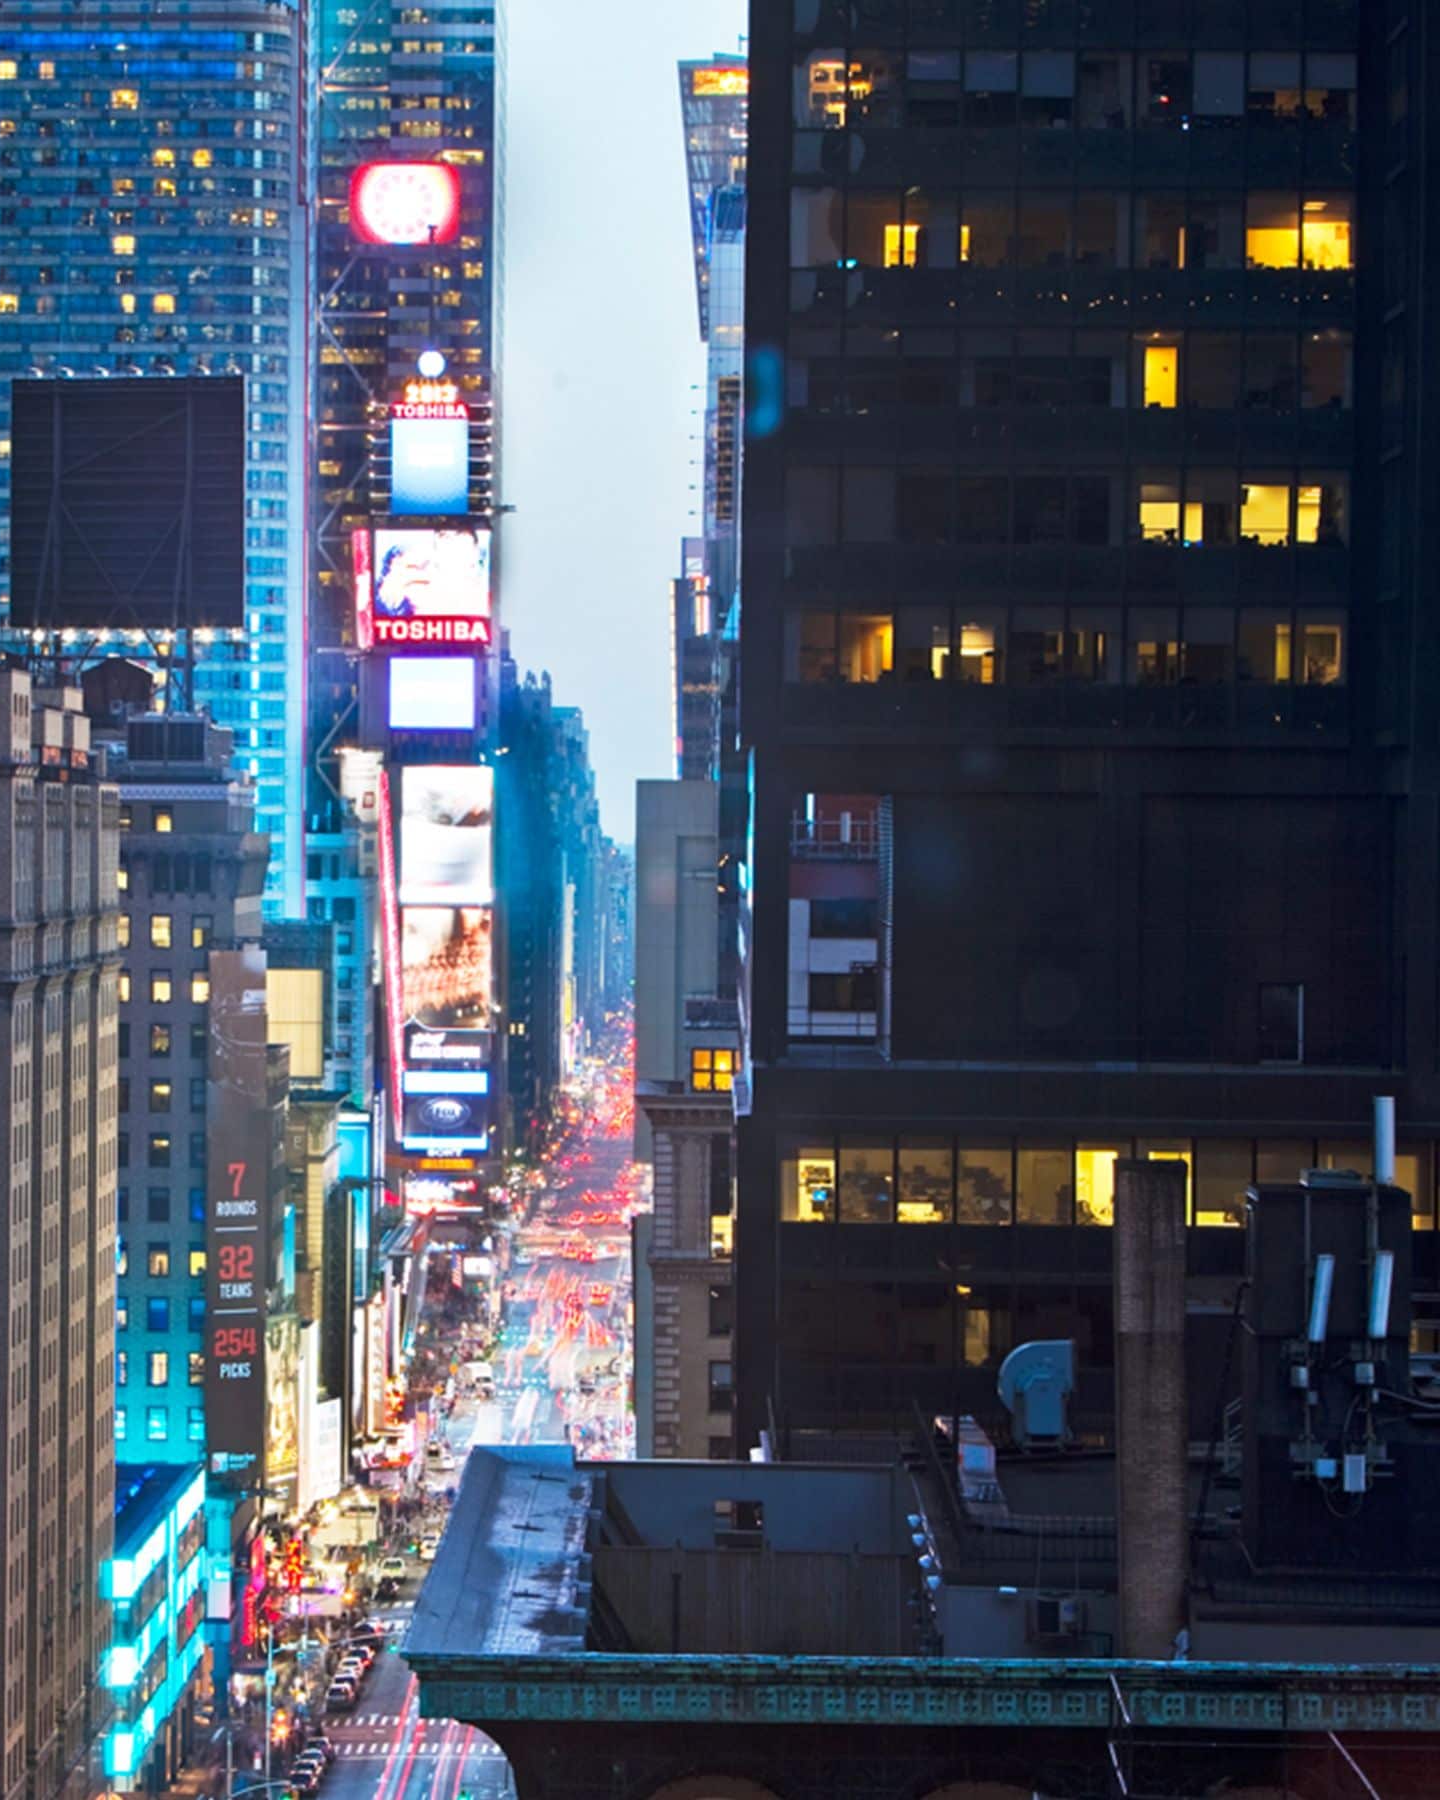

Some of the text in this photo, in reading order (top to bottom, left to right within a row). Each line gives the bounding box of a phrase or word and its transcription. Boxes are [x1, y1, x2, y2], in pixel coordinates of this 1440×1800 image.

[394, 403, 468, 418] TOSHIBA
[375, 619, 489, 642] TOSHIBA
[227, 1162, 247, 1198] 7
[216, 1200, 257, 1216] ROUNDS
[218, 1245, 253, 1279] 32
[220, 1282, 253, 1299] TEAMS
[213, 1327, 257, 1357] 254
[220, 1362, 252, 1379] PICKS
